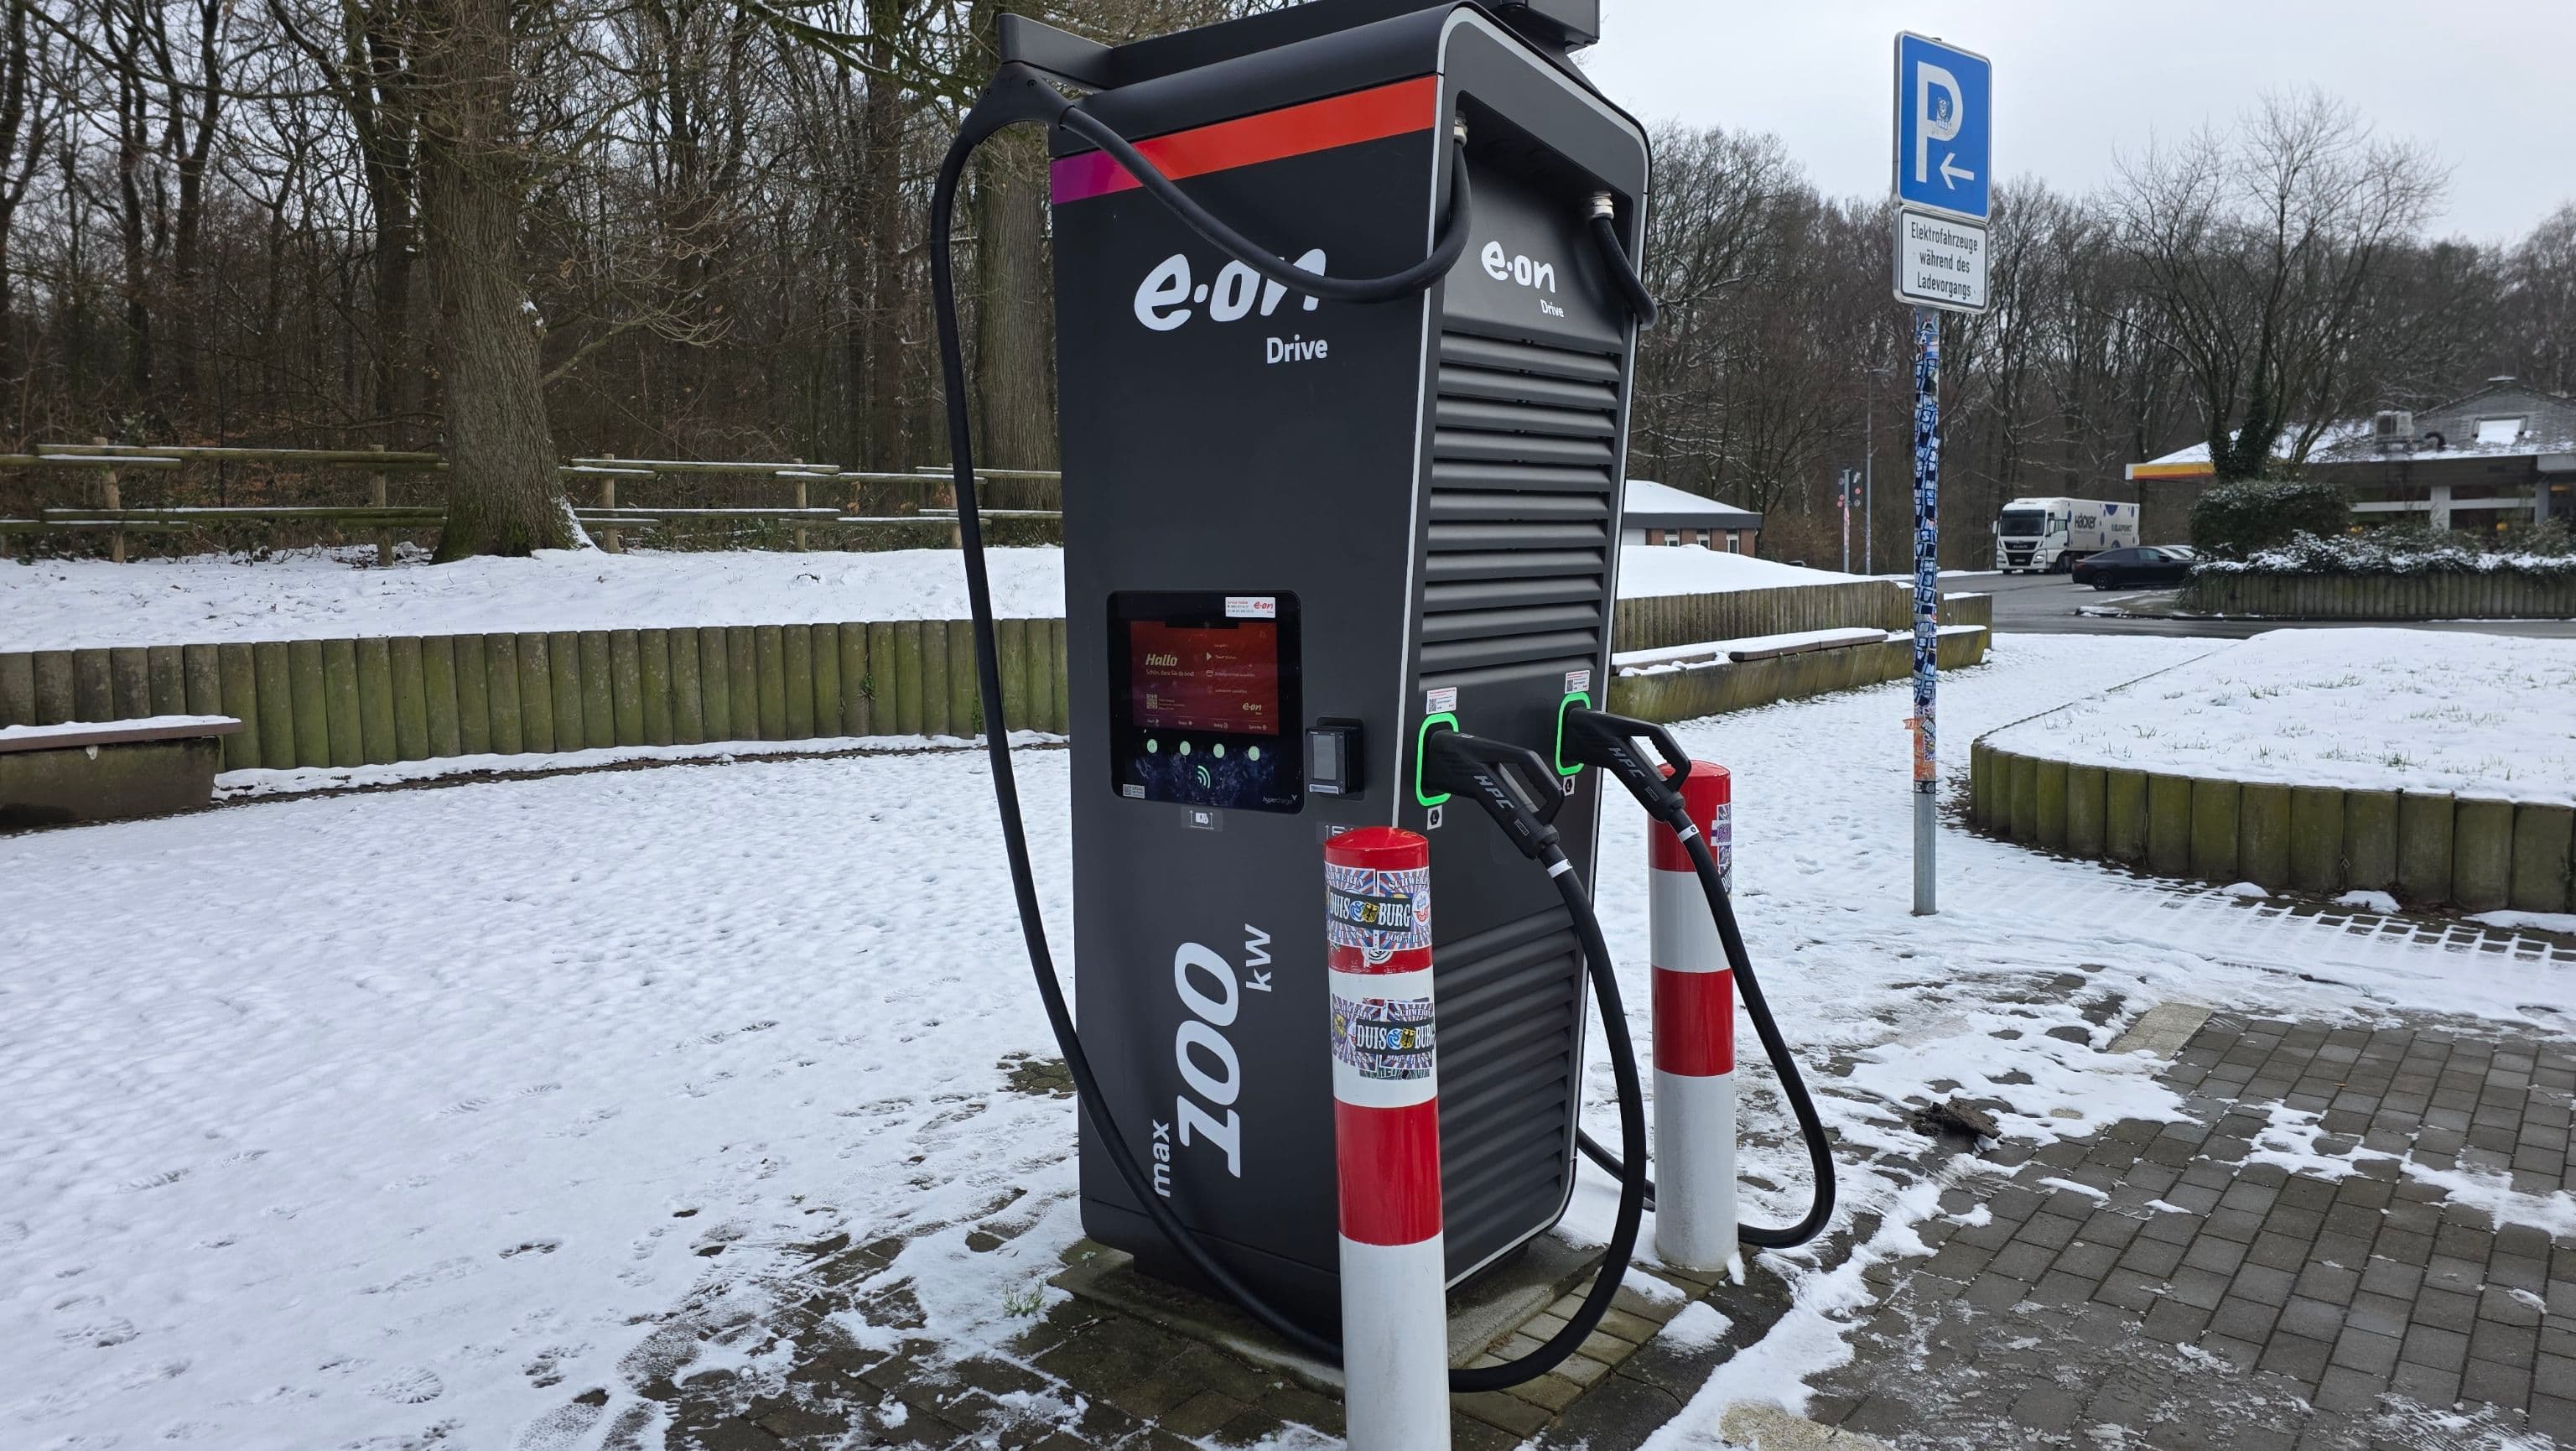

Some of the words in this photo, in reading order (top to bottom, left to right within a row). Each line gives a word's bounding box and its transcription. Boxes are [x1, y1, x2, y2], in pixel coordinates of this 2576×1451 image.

[1916, 61, 1963, 183] P
[1911, 221, 1978, 252] Elektrofahrzeuge
[1919, 249, 1954, 270] während
[1956, 254, 1971, 273] des
[1917, 271, 1971, 298] Ladevorgangs
[1540, 299, 1565, 319] Drive
[1266, 335, 1327, 364] Drive
[1145, 653, 1178, 666] Hallo
[1607, 747, 1645, 777] HPC
[1473, 775, 1515, 809] HPC
[1329, 892, 1350, 920] DUIS
[1378, 902, 1410, 928] BURG
[1357, 1025, 1387, 1050] DUIS
[1152, 1119, 1171, 1199] max
[1174, 942, 1241, 1178] 100
[1244, 923, 1272, 992] kW
